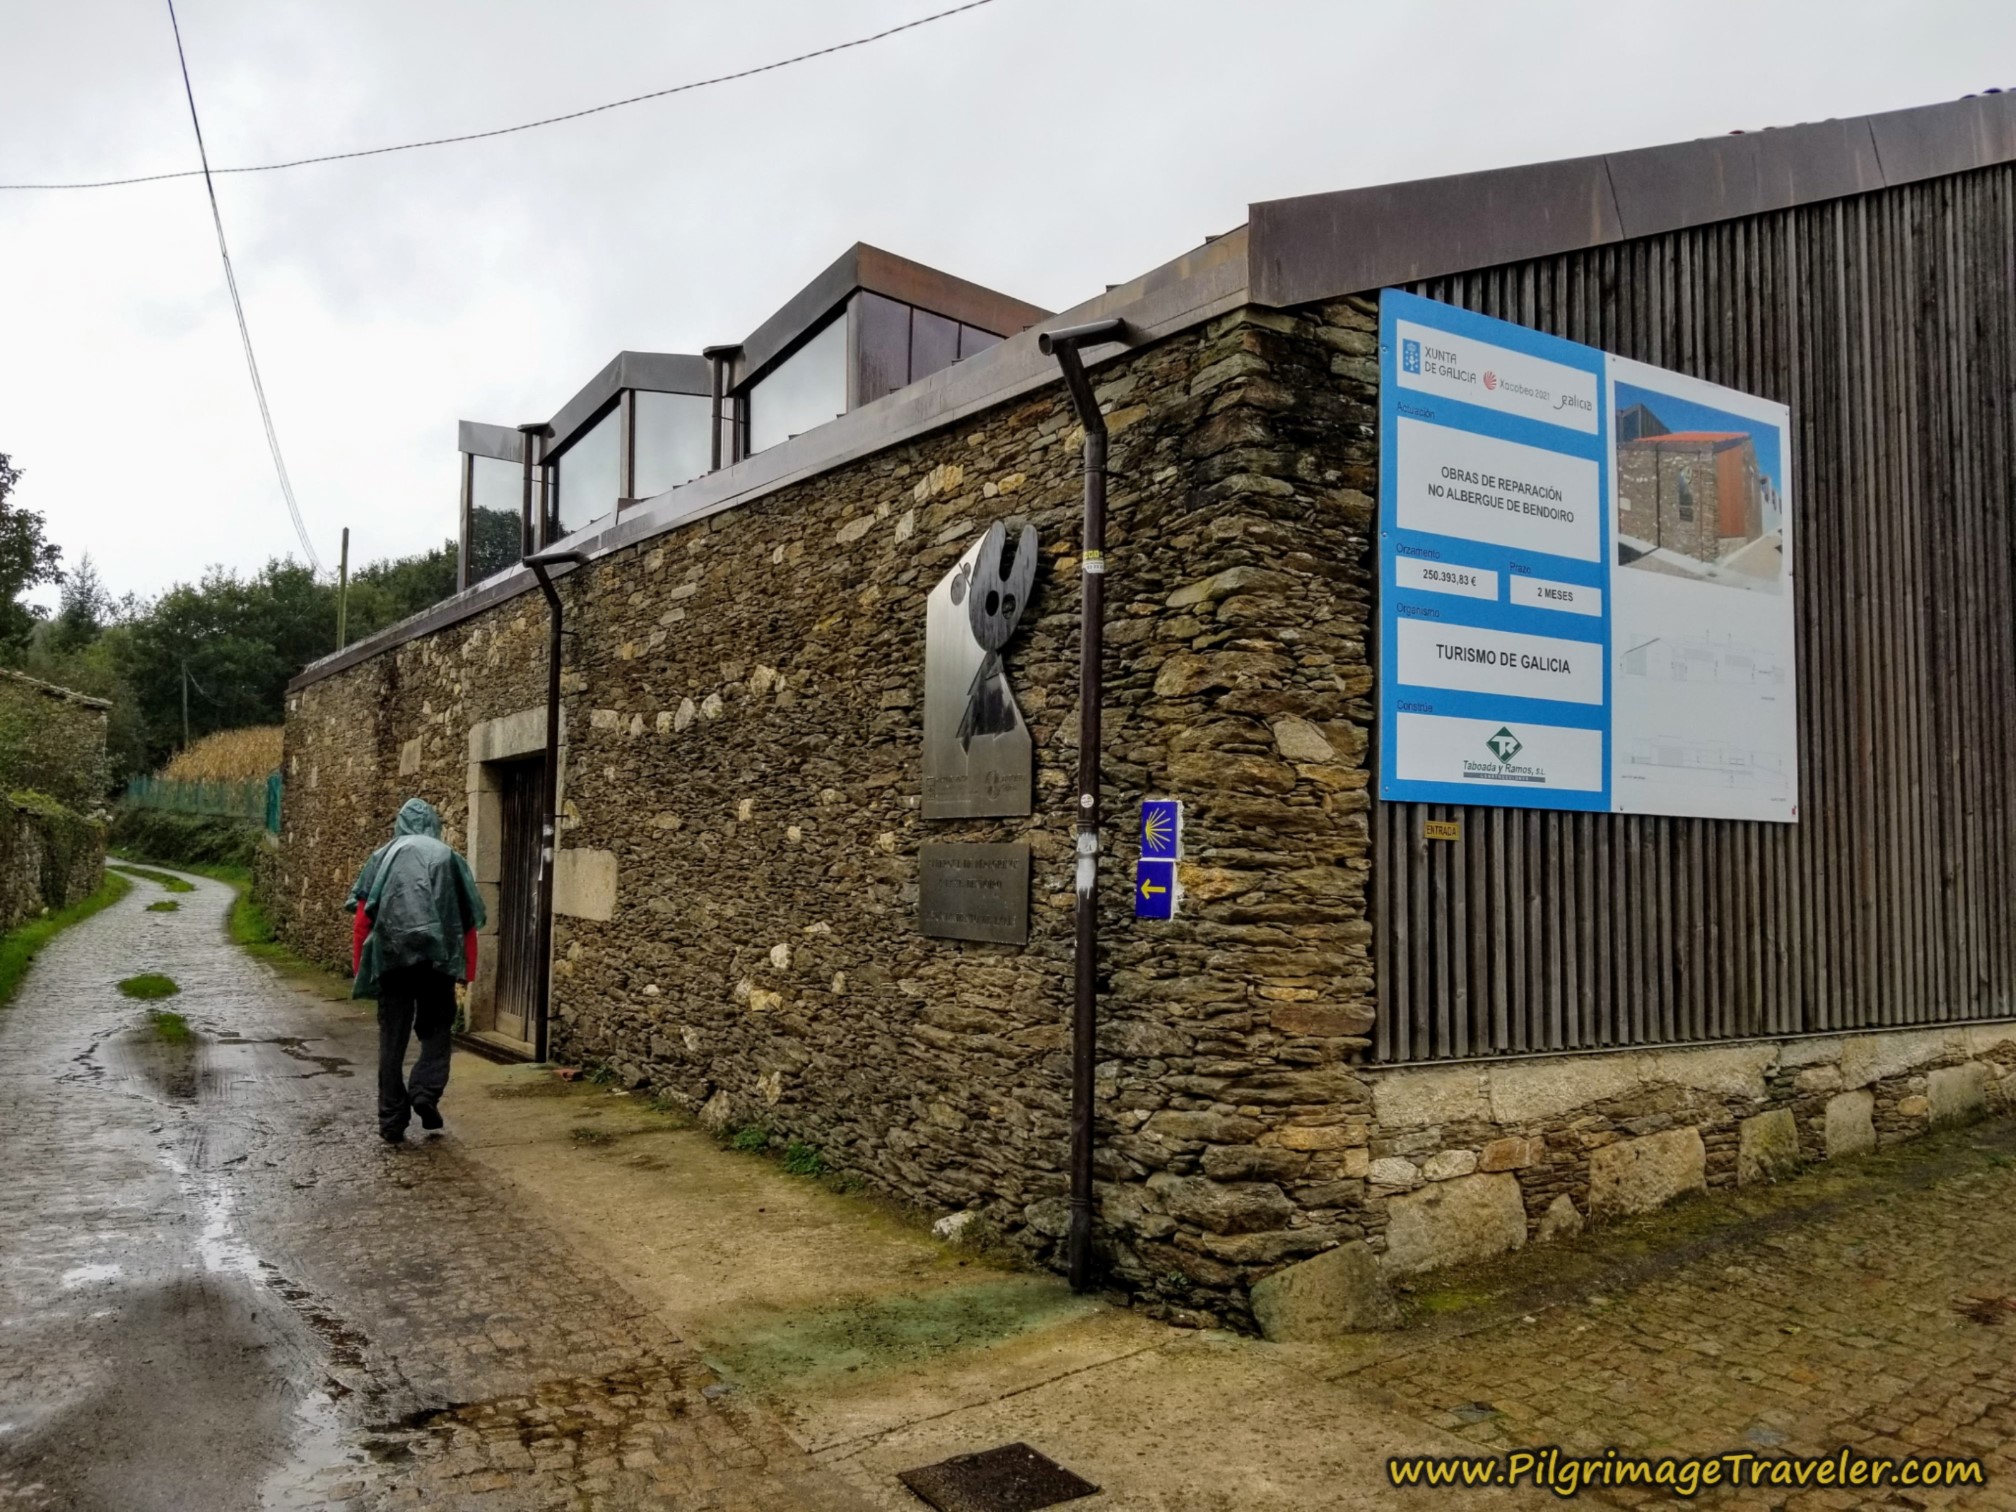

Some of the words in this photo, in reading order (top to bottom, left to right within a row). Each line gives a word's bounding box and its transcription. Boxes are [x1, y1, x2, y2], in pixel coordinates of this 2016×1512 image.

[1425, 346, 1457, 365] XUNTA
[1425, 361, 1437, 374] DE
[1439, 365, 1477, 384] GALICIA
[1500, 379, 1534, 397] Xacobeo
[1535, 389, 1550, 401] 2021
[1553, 394, 1592, 411] galicia
[1441, 466, 1479, 484] OBRAS
[1482, 474, 1496, 488] DE
[1498, 477, 1562, 502] REPARACIÓN
[1428, 483, 1444, 497] NO
[1446, 487, 1504, 510] ALBERGUE
[1507, 499, 1520, 512] DE
[1523, 502, 1574, 523] BENDOIRO
[1396, 543, 1440, 560] Orzamento
[1510, 562, 1532, 575] Prazo
[1423, 569, 1469, 587] 250.393,83
[1471, 576, 1477, 587] €
[1537, 587, 1543, 597] 2
[1545, 588, 1574, 602] MESES
[1396, 602, 1440, 618] Organismo
[1436, 644, 1496, 665] TURISMO
[1500, 652, 1517, 667] DE
[1521, 654, 1571, 674] GALICIA
[1463, 760, 1496, 773] Taboada
[1498, 764, 1503, 775] y
[1505, 763, 1534, 776] Ramos,
[1426, 825, 1457, 837] ENTRADA
